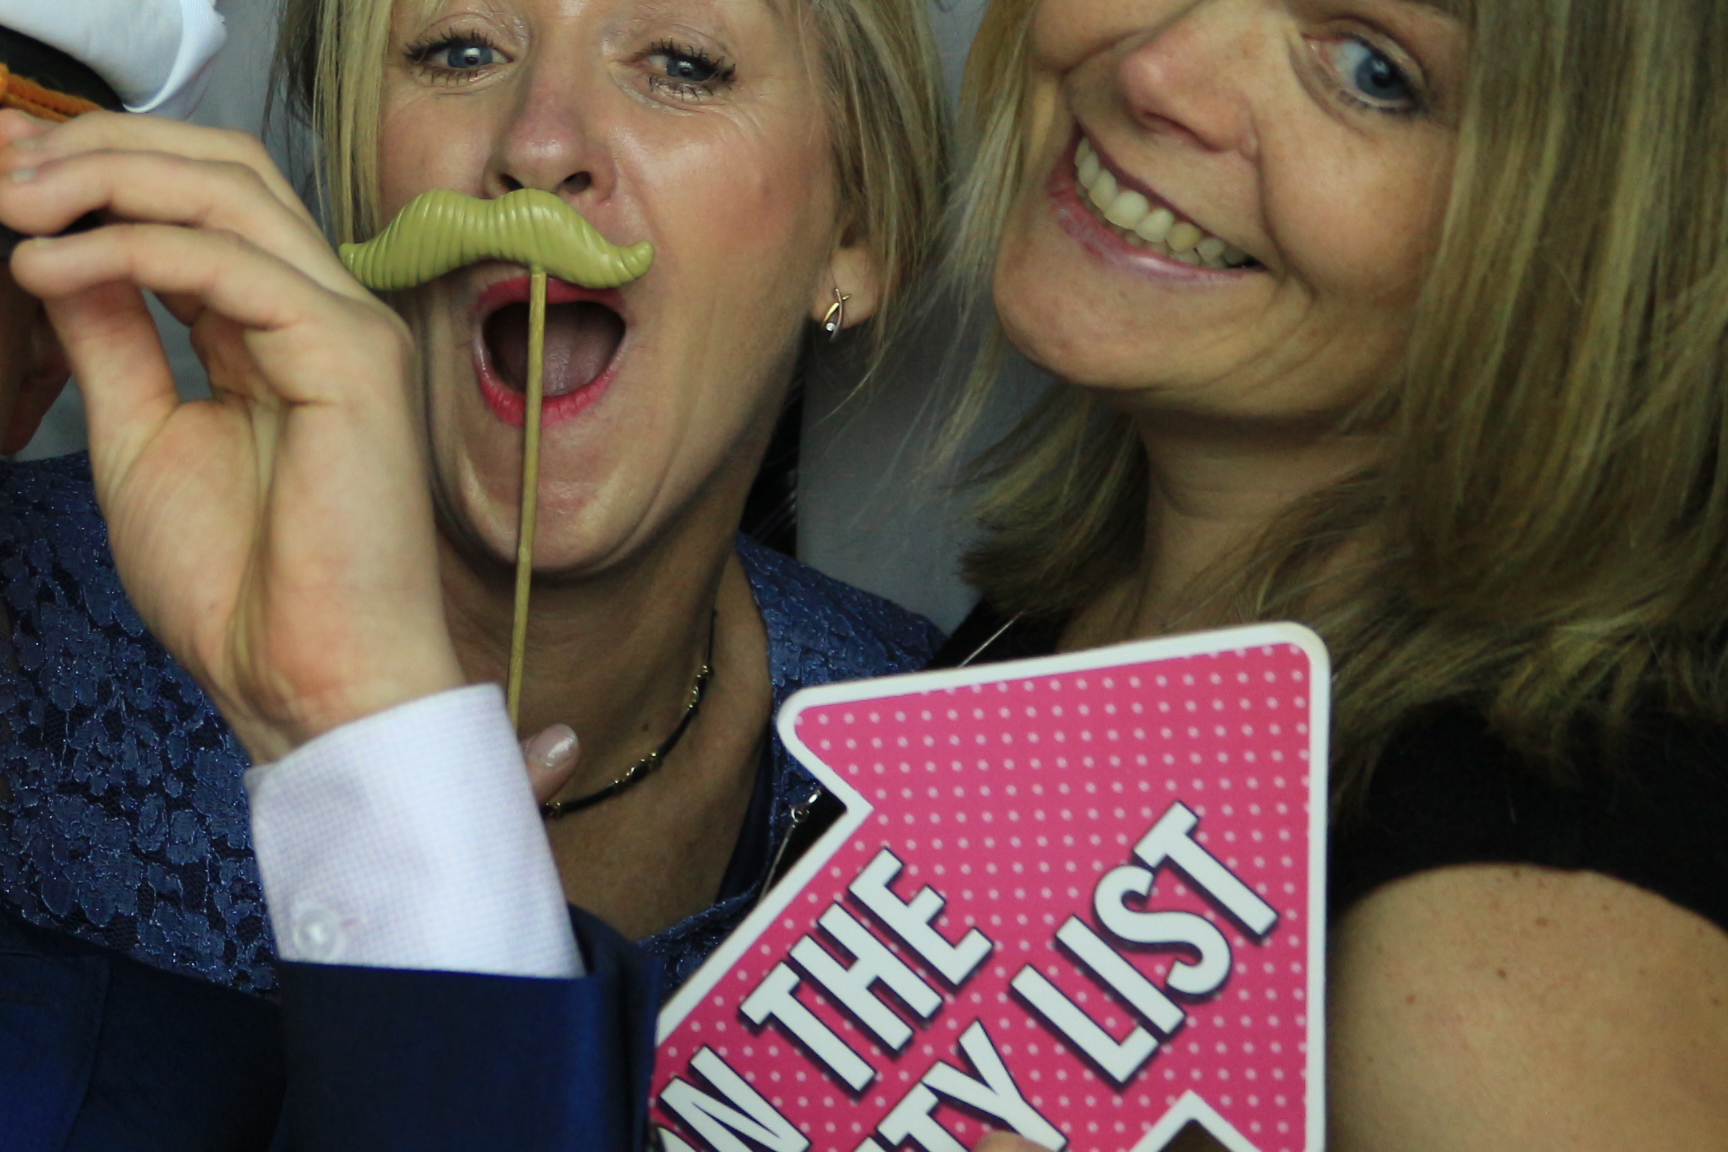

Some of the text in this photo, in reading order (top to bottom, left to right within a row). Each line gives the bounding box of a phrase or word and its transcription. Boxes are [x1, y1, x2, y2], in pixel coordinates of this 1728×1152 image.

[656, 847, 994, 1152] N THE
[1010, 799, 1279, 1086] LIST
